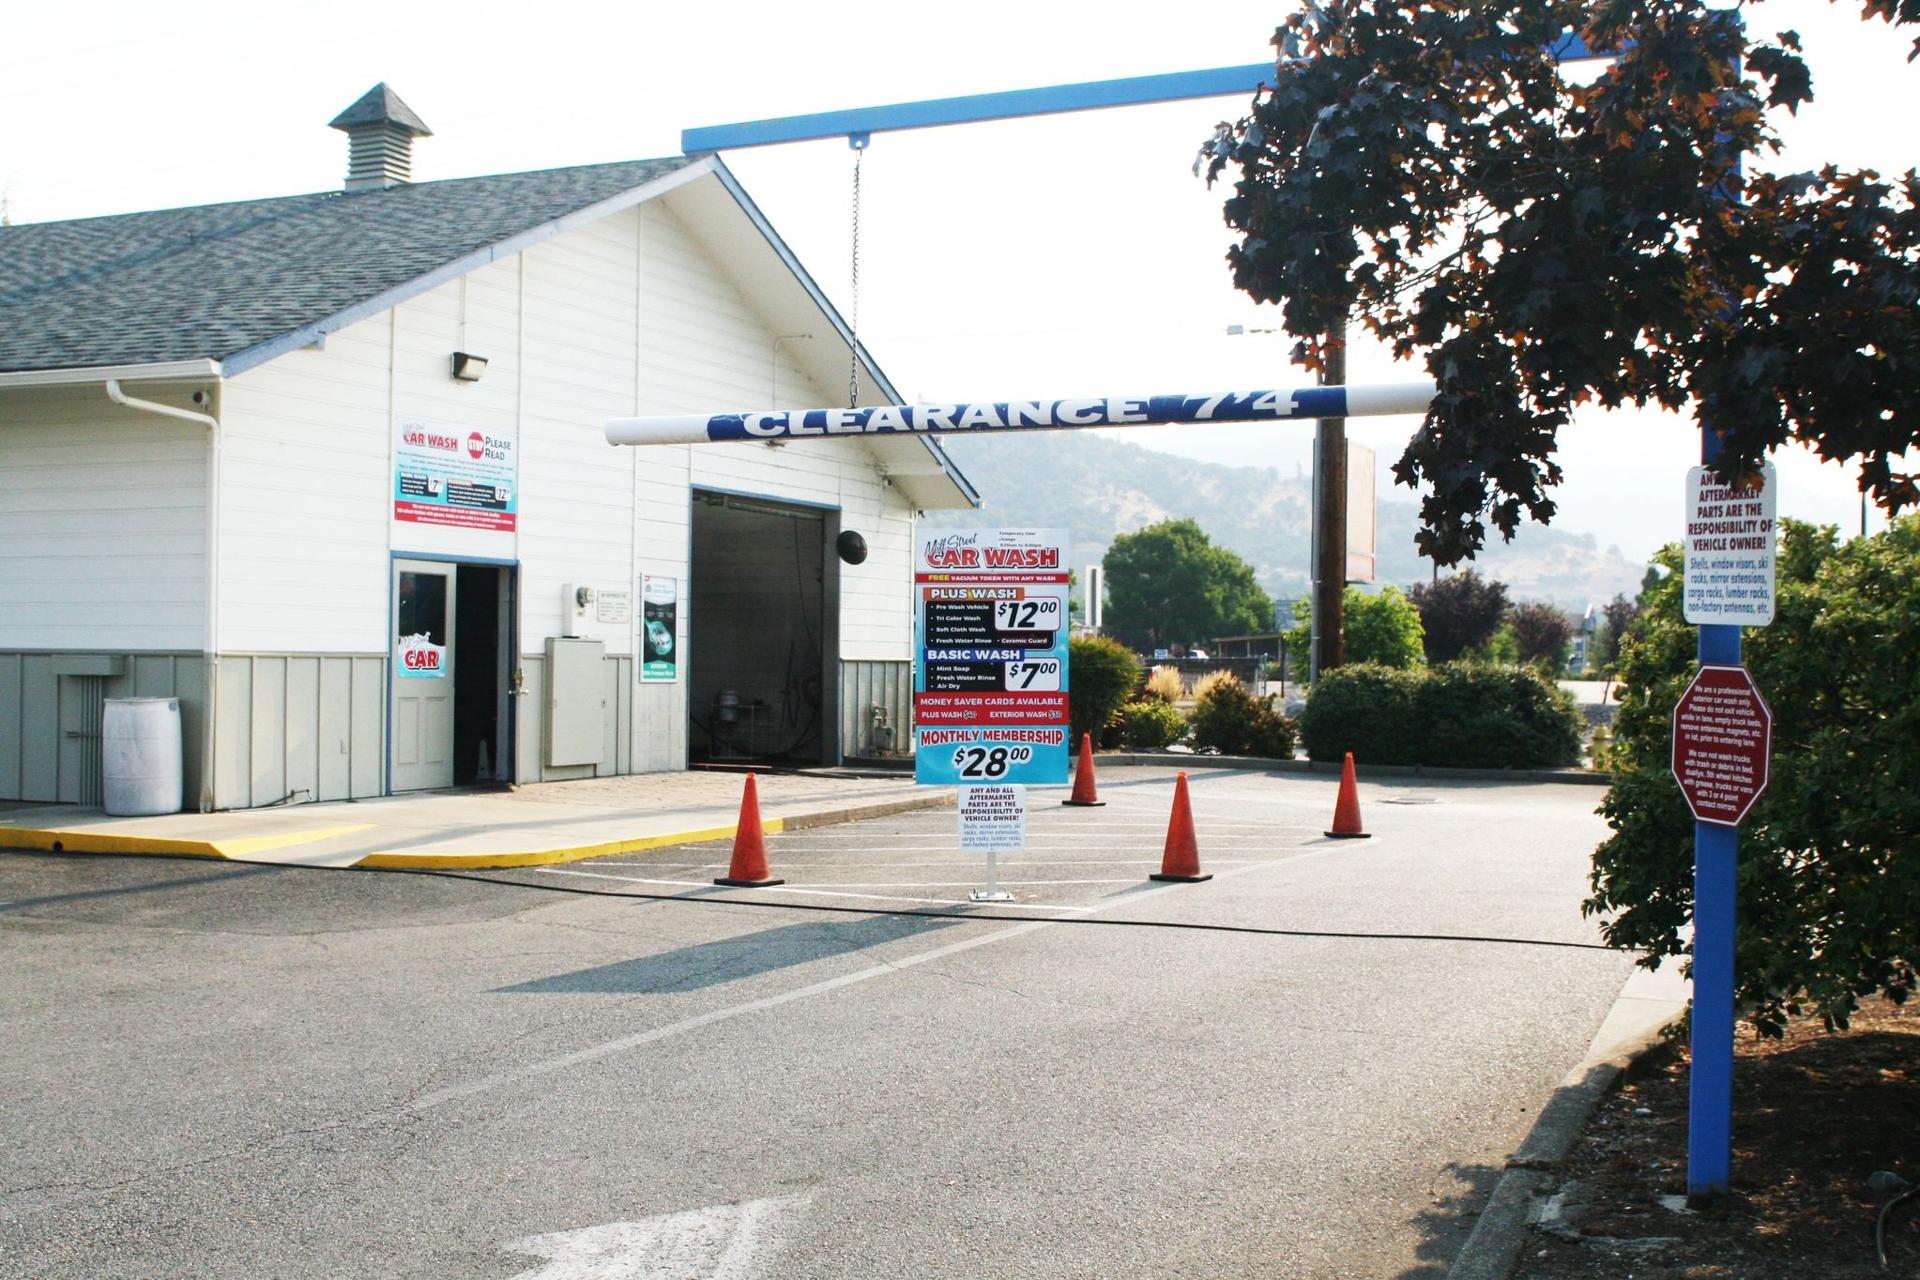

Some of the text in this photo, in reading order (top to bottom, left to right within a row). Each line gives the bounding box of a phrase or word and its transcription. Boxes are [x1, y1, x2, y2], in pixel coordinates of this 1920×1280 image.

[743, 395, 1149, 436] CLEARANCE
[403, 432, 458, 451] CAR WASH
[1698, 503, 1762, 518] PARTS ARE THE
[1689, 519, 1772, 535] RESPONSIBILITY OF
[925, 533, 978, 557] Mill Street
[1694, 537, 1766, 551] VEHICLE OWNER!
[927, 548, 1058, 568] CAR WASH
[1691, 556, 1768, 570] Shells, window visors, ski
[1691, 572, 1767, 585] racks, mirror extensions,
[931, 589, 1016, 598] PLUS WASH
[1688, 586, 1769, 601] cargo racks, lumber racks,
[1688, 600, 1769, 616] non-factory antennas, etc.
[405, 650, 440, 669] CAR
[928, 650, 1020, 660] BASIC WASH
[1718, 687, 1750, 695] professional
[1689, 704, 1706, 712] Please
[1736, 708, 1754, 716] vehicle
[1715, 717, 1731, 726] empty
[920, 730, 1064, 746] MONTHLY MEMBERSHIP
[1720, 738, 1742, 747] entering
[1697, 760, 1710, 768] trash
[1734, 755, 1750, 763] trucks
[1716, 772, 1731, 780] wheel
[1732, 774, 1752, 783] hitches
[1715, 783, 1732, 791] trucks
[1697, 800, 1716, 808] contact
